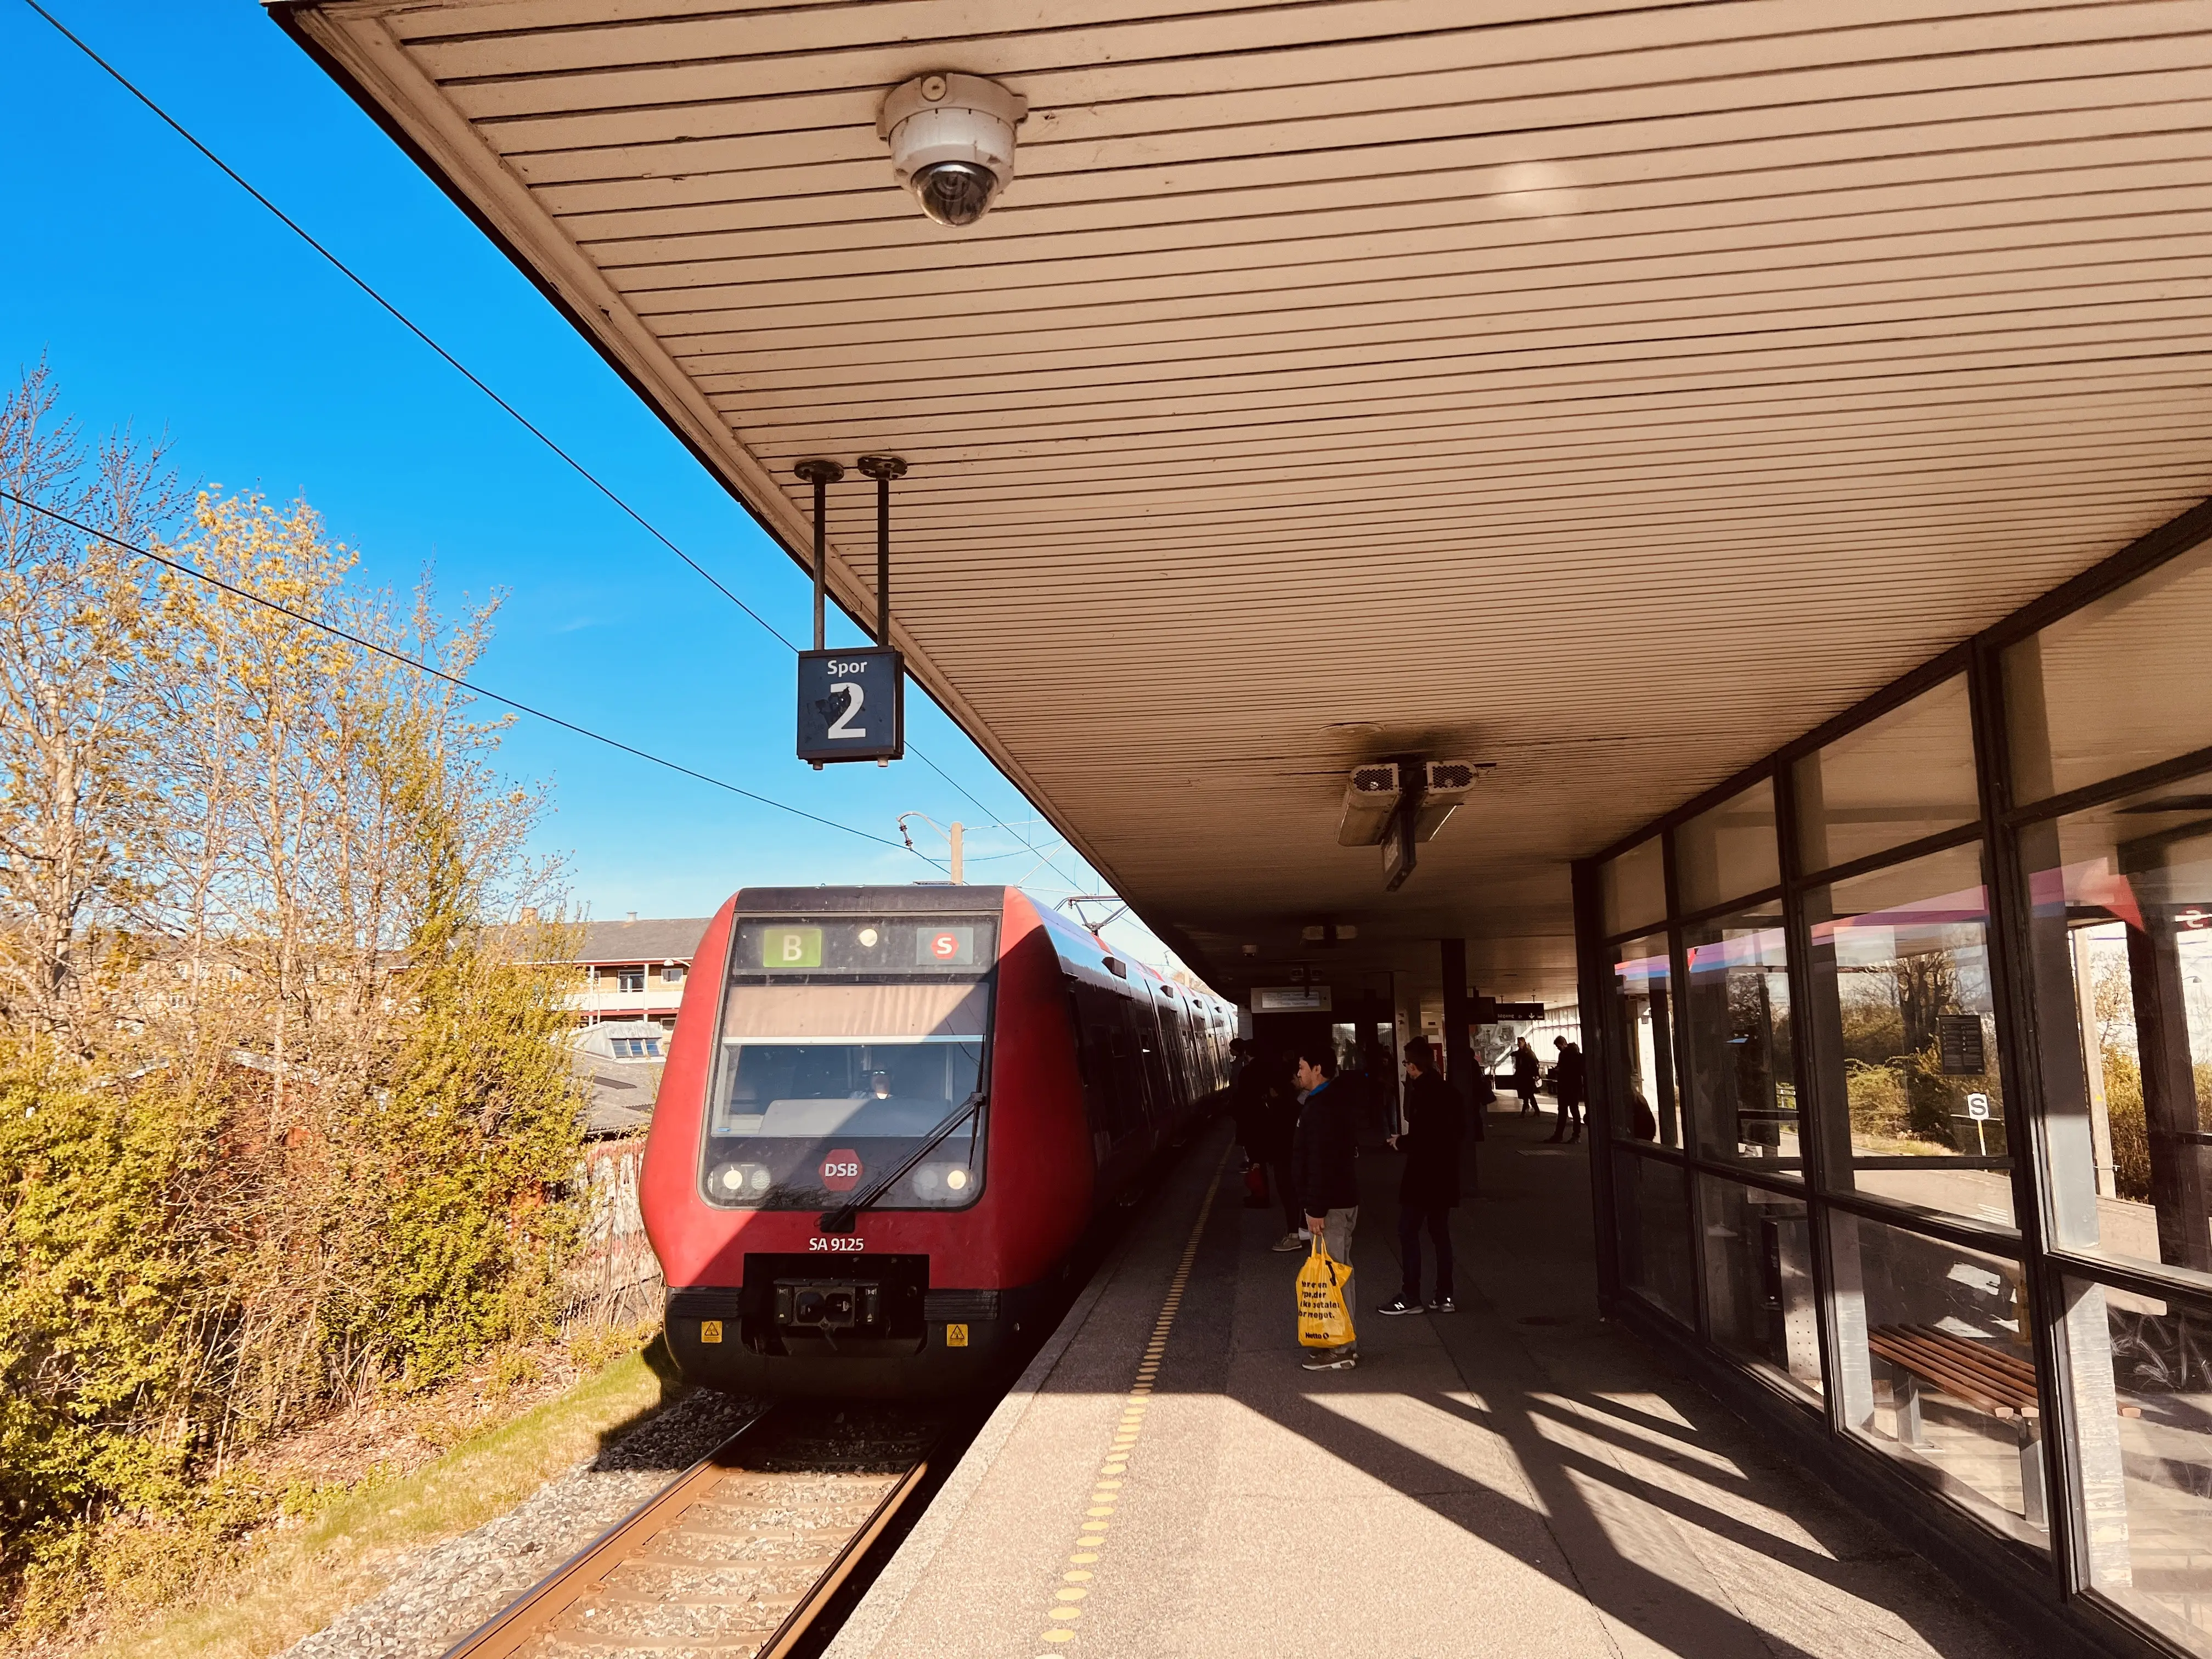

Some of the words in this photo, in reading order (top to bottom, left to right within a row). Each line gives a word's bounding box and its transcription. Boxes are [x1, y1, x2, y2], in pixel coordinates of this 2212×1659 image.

[827, 660, 867, 677] Spor
[828, 682, 866, 739] 2
[782, 935, 802, 961] B
[936, 937, 952, 955] S
[1971, 1098, 1986, 1115] S
[825, 1163, 858, 1177] DSB
[809, 1238, 828, 1251] SA
[831, 1238, 864, 1251] 9125
